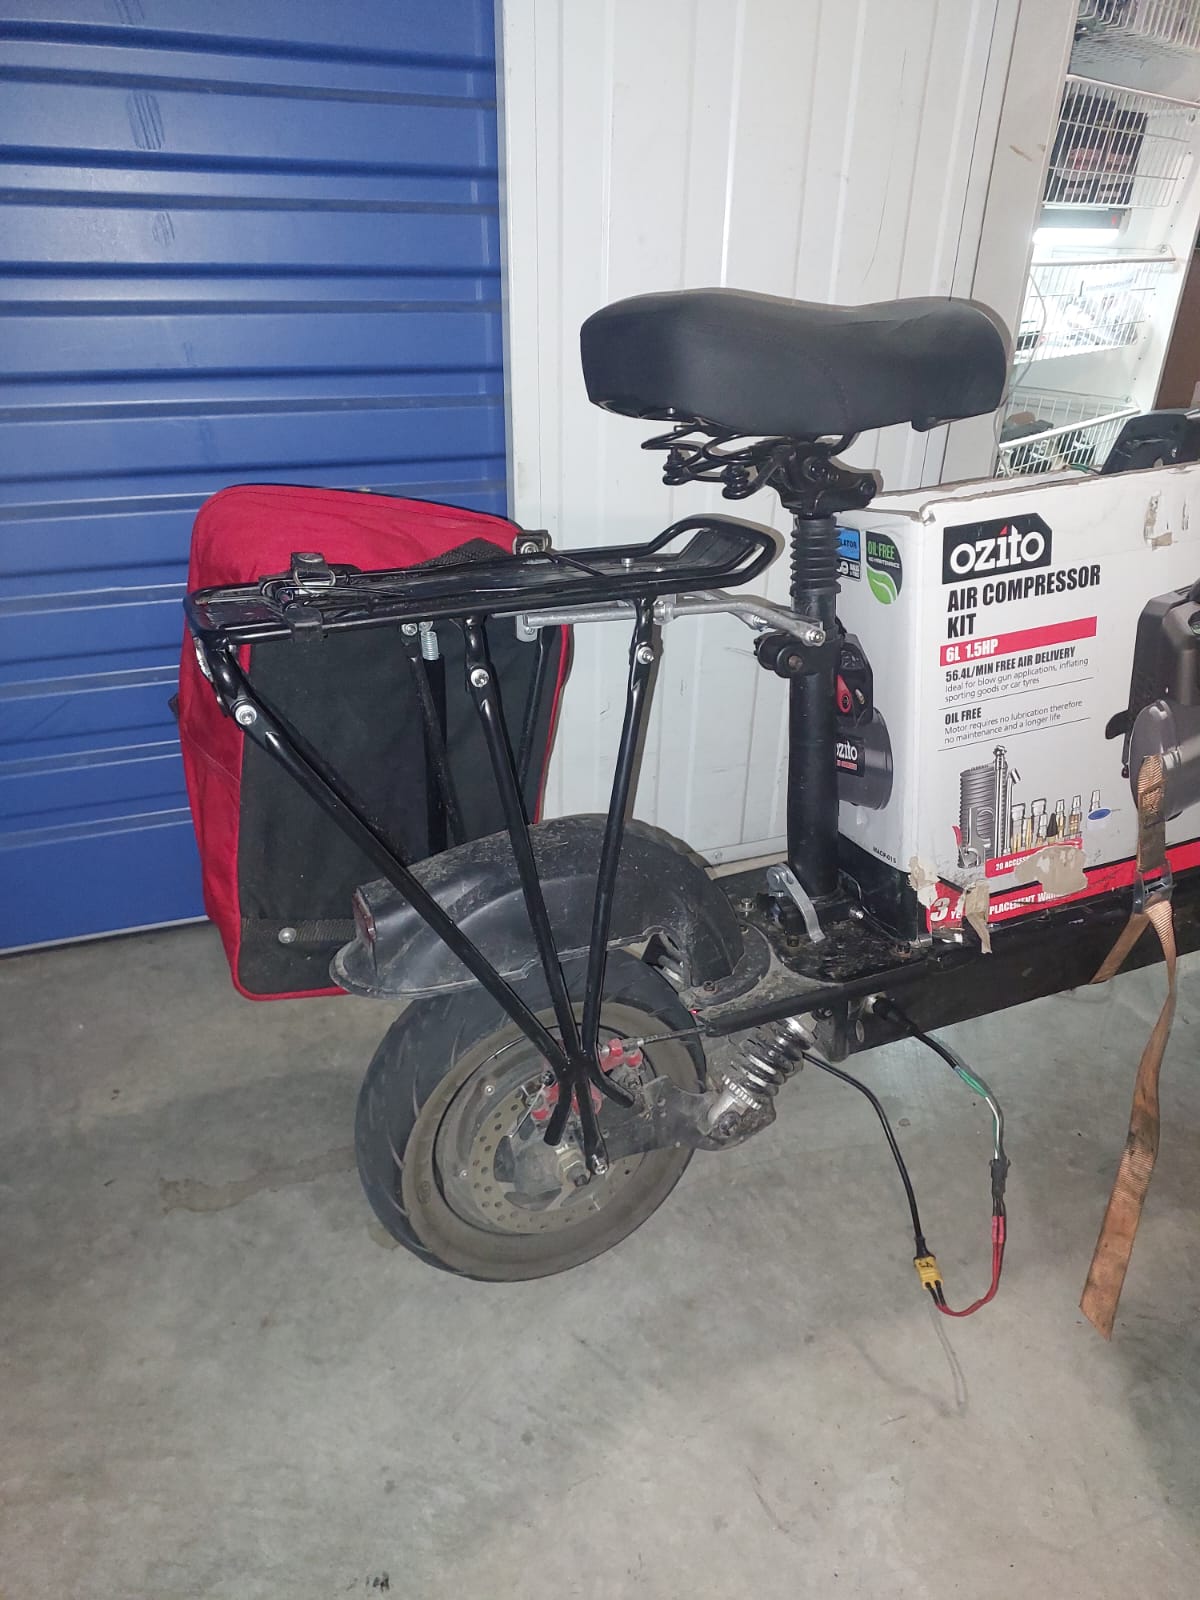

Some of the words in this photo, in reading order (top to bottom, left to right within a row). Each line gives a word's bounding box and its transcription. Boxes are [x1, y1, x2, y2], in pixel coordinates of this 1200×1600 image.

[868, 541, 878, 556] OIL
[879, 543, 895, 560] FREE
[950, 525, 1045, 574] ozito
[947, 586, 977, 612] AIR
[982, 564, 1101, 606] COMPRESSOR
[947, 613, 976, 638] KIT
[946, 646, 960, 662] 6L
[966, 638, 998, 659] 1.5HP
[945, 682, 963, 693] Ideal
[965, 680, 976, 689] for
[978, 677, 996, 687] blow
[998, 674, 1012, 683] gun
[1013, 664, 1057, 680] applications,
[1059, 658, 1089, 671] inflating
[946, 663, 994, 683] 56.4L/MIN
[996, 658, 1016, 672] FREE
[1018, 655, 1033, 668] AIR
[1035, 646, 1076, 665] DELIVERY
[945, 689, 975, 703] sporting
[977, 684, 999, 698] goods
[1001, 683, 1009, 691] or
[1010, 681, 1021, 689] car
[1023, 677, 1040, 688] tyres
[944, 724, 968, 735] Motor
[969, 718, 998, 732] requires
[1011, 707, 1049, 721] lubrication
[1050, 700, 1083, 712] therefore
[945, 712, 959, 725] OIL
[961, 707, 982, 721] FREE
[956, 727, 1002, 742] maintenance
[1004, 723, 1018, 732] and
[1025, 716, 1048, 727] longer
[1049, 712, 1061, 721] life
[995, 862, 1004, 871] 20
[930, 897, 951, 921] 3
[951, 909, 962, 919] YE
[989, 893, 1036, 915] PLACEMENT
